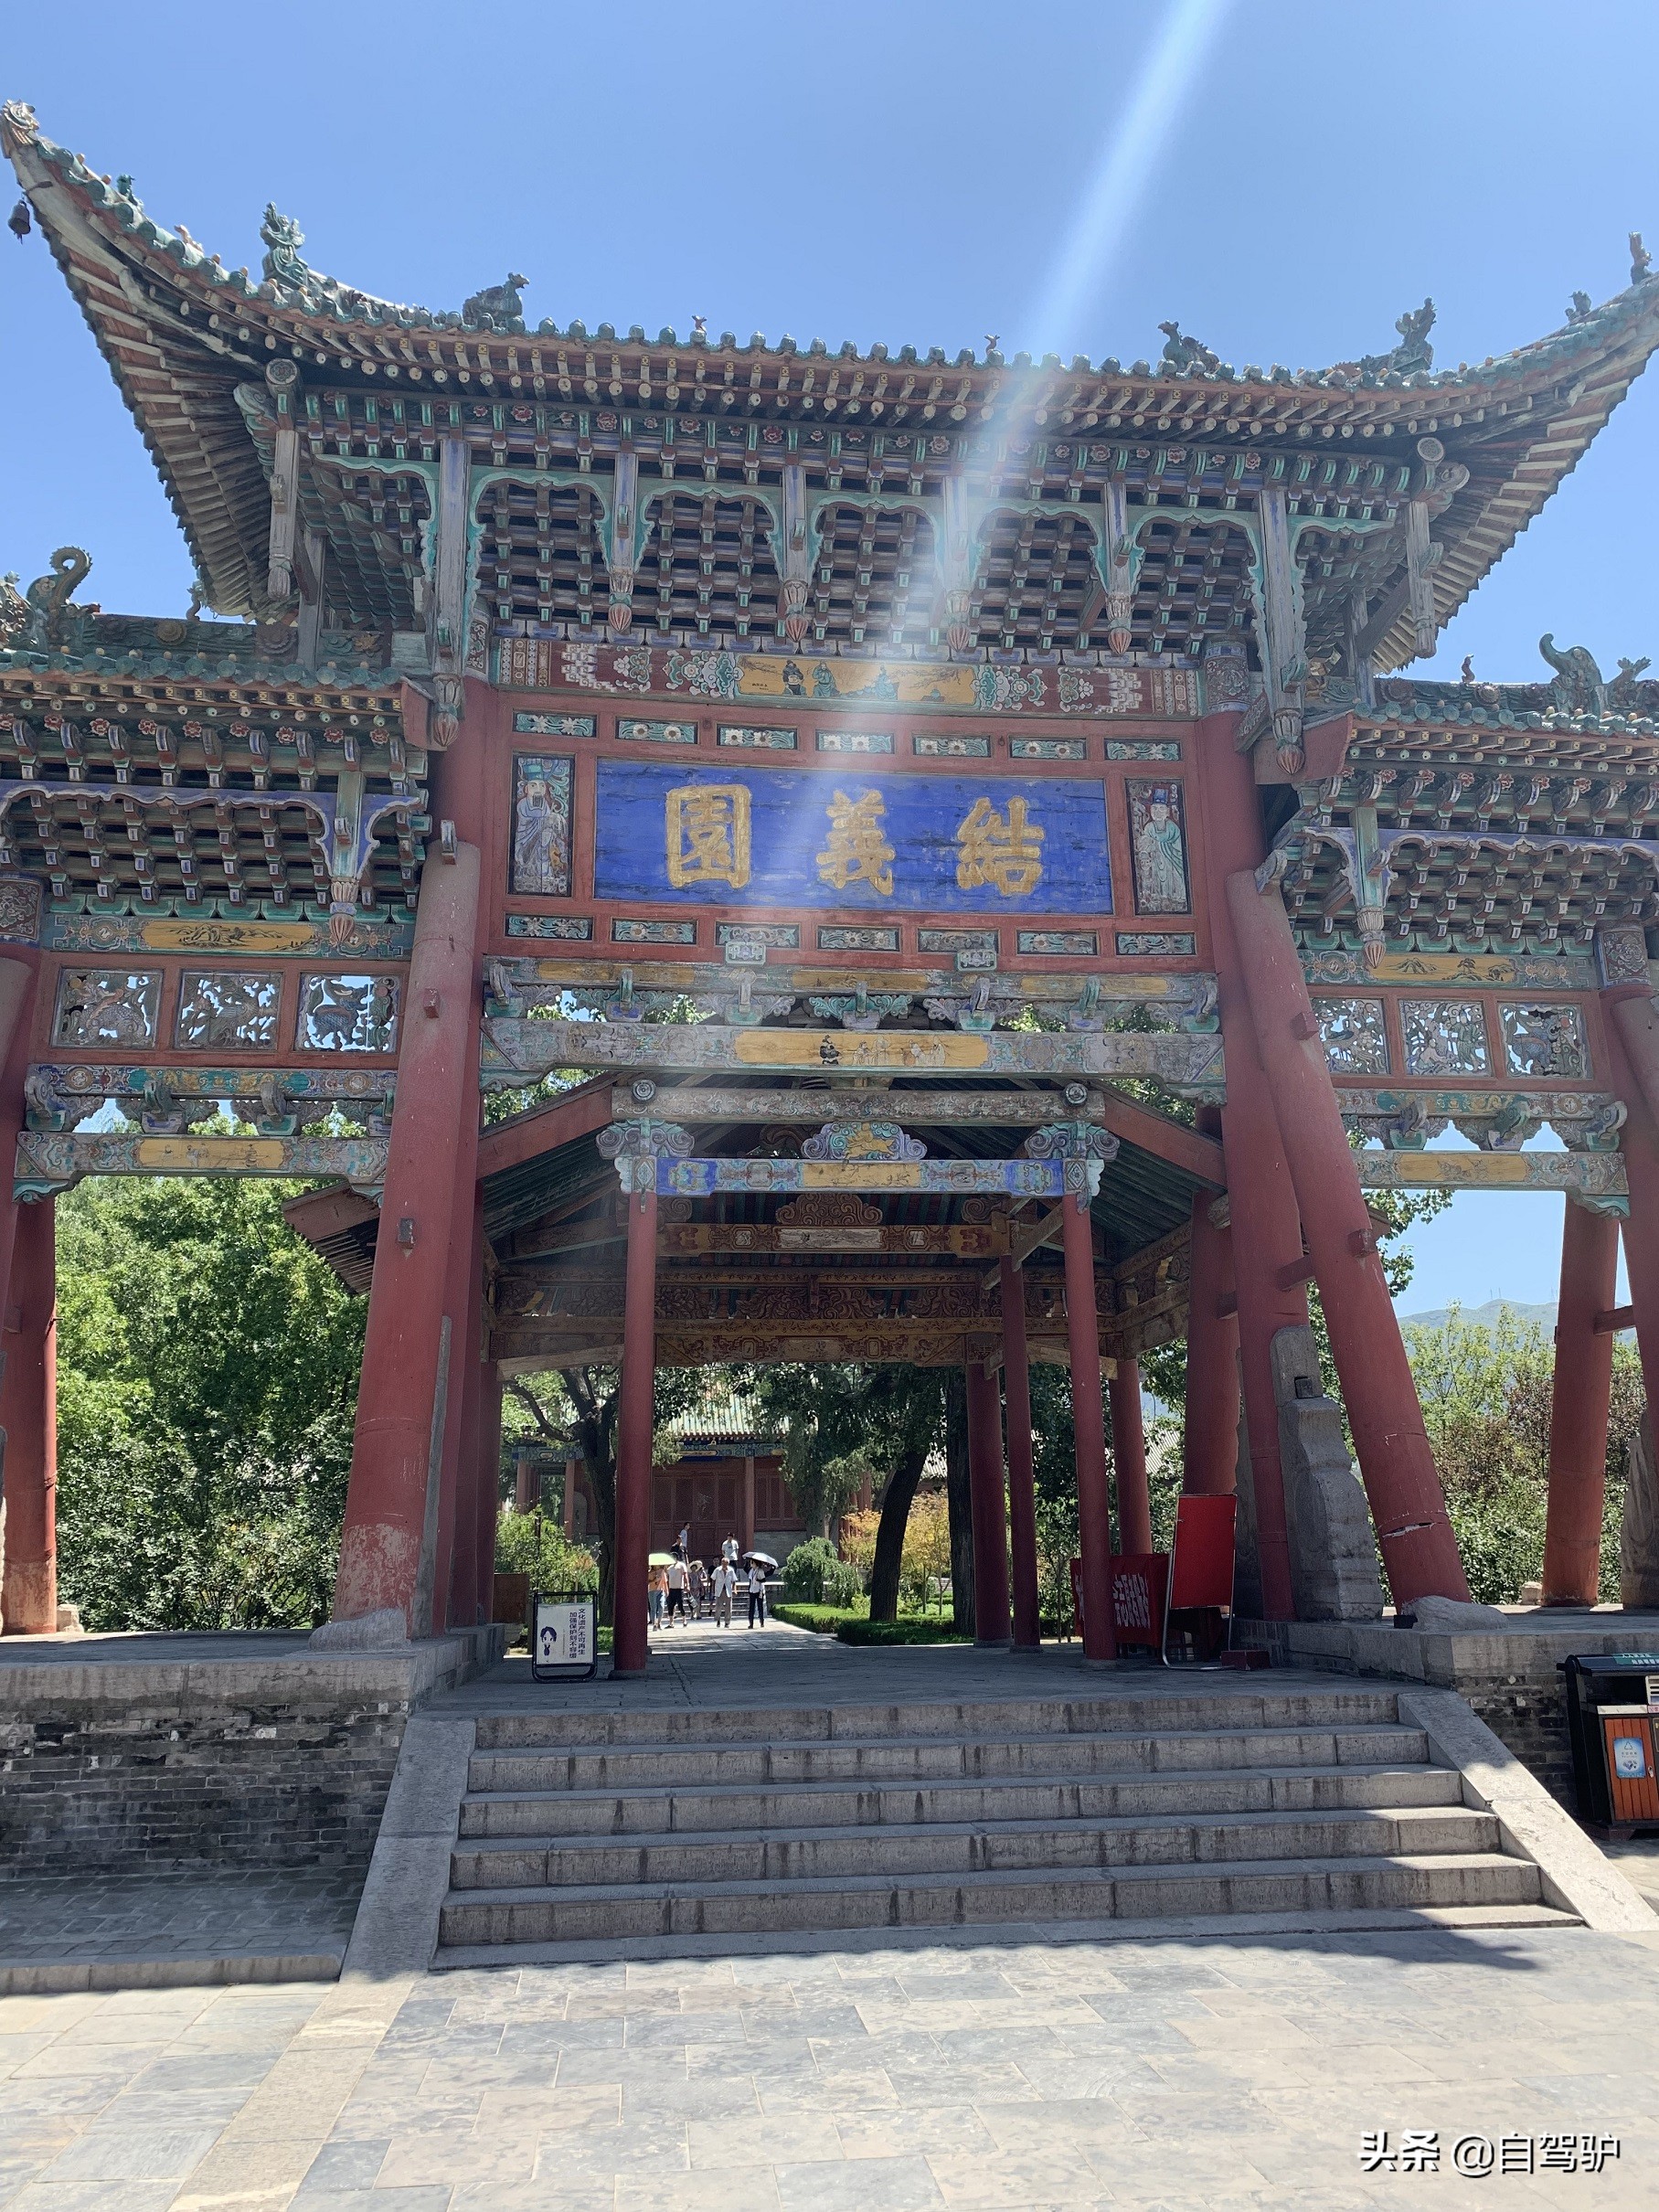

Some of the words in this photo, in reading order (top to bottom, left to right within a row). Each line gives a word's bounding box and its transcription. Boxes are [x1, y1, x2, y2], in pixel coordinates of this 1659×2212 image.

[569, 1611, 578, 1659] 加强保护刻不容缓
[578, 1608, 586, 1655] 文化遗产不可再生
